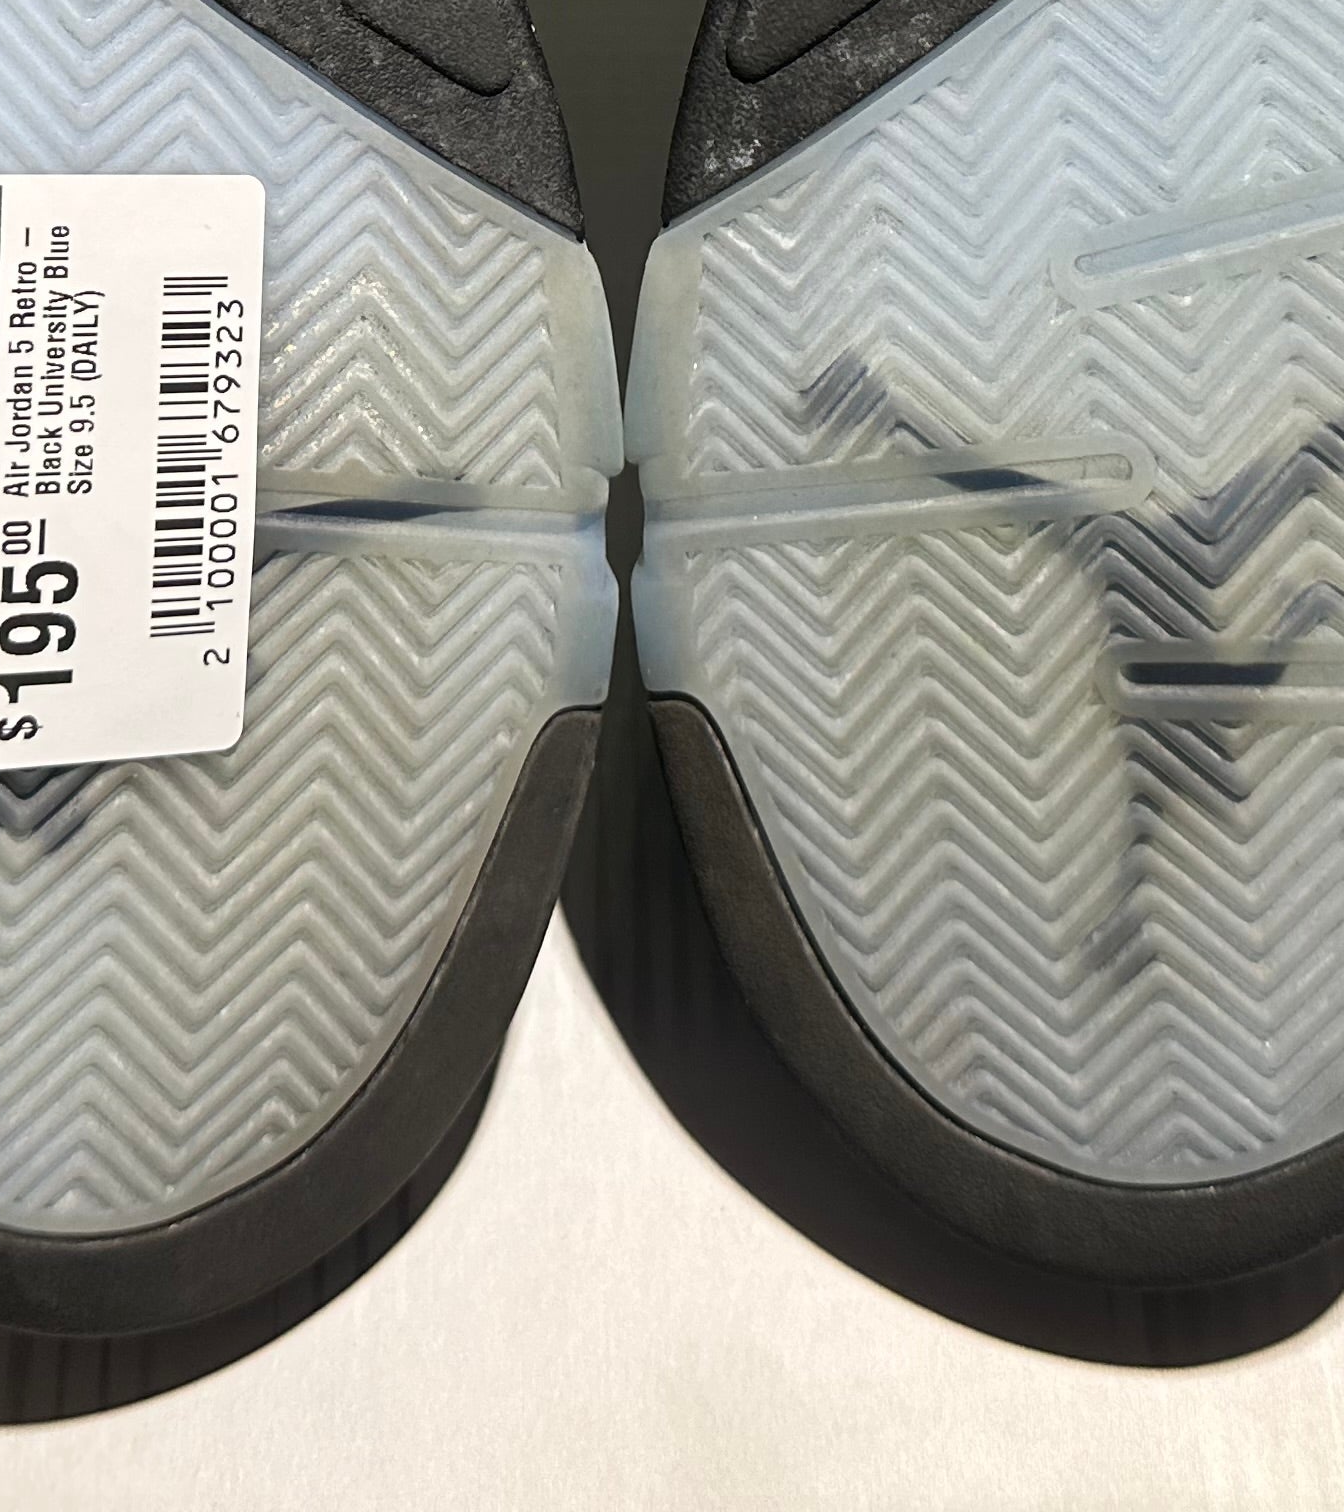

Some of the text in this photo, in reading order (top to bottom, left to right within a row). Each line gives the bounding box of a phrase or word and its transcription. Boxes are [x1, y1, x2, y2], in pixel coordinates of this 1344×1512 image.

[7, 339, 35, 355] 5
[8, 261, 38, 328] Retro
[4, 364, 34, 454] Jordan
[35, 224, 74, 495] Black University Blue
[66, 289, 106, 495] Size 9.5 (DAILY)
[212, 298, 245, 445] 679323
[2, 463, 31, 498] Air
[205, 473, 240, 611] 100001
